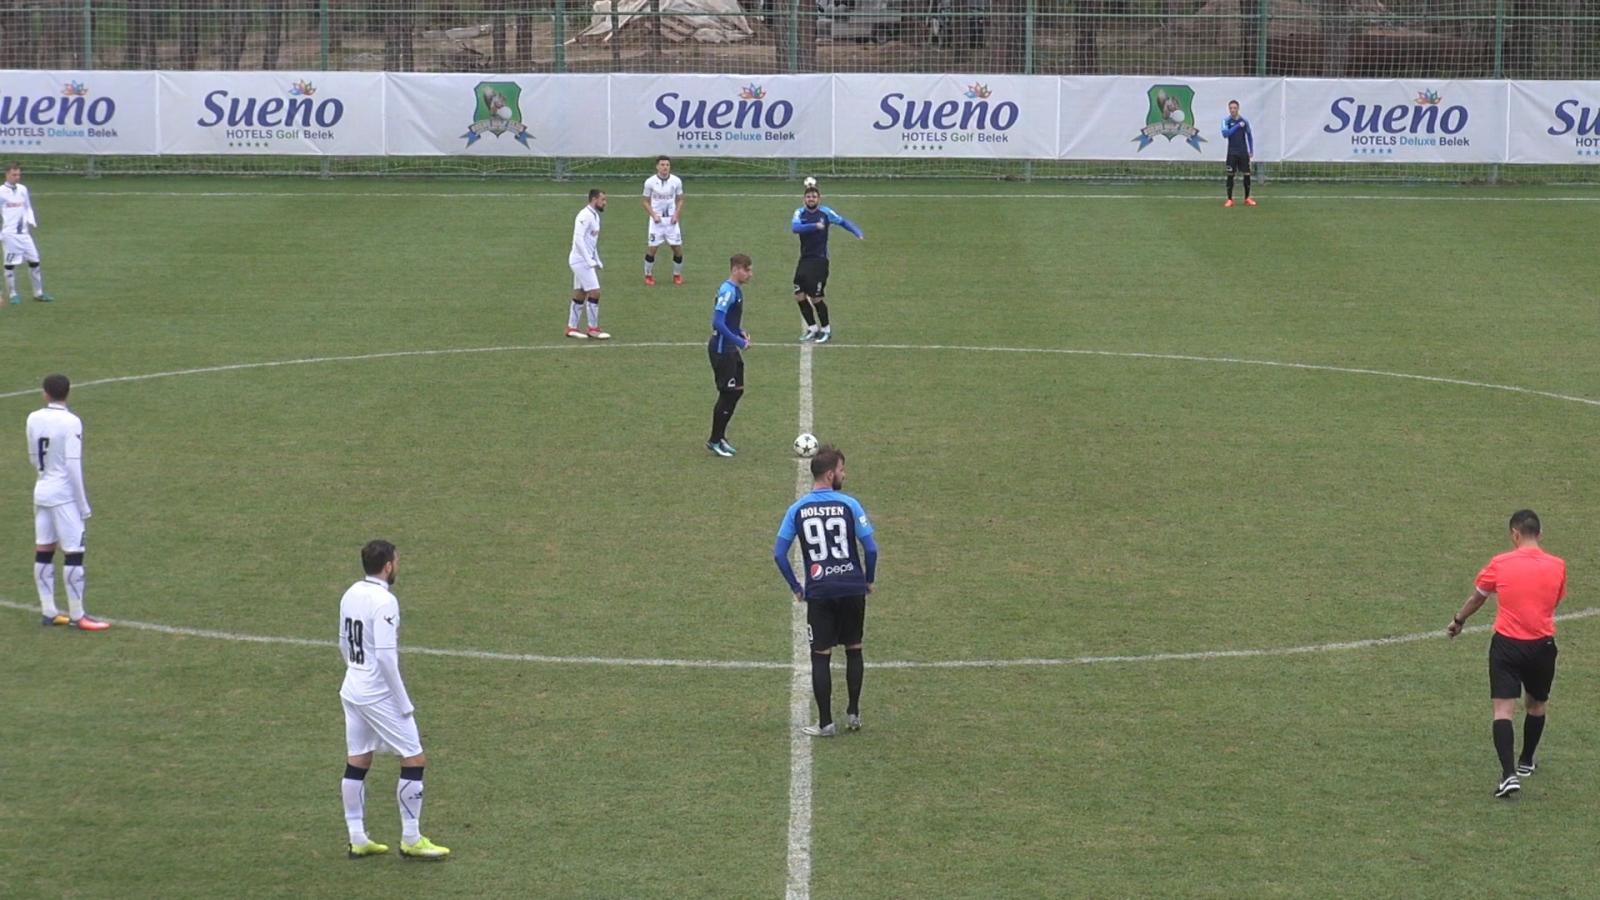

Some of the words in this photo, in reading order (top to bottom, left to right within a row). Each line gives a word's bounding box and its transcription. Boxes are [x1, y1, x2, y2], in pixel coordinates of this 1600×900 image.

[47, 128, 85, 138] Deluxe
[87, 128, 118, 138] Belek
[226, 129, 273, 139] HOTELS
[275, 129, 299, 140] Golf
[303, 130, 334, 140] Belek
[676, 131, 723, 141] HOTELS
[724, 131, 762, 142] Deluxe
[764, 132, 795, 141] Belek
[901, 132, 947, 142] HOTELS
[950, 132, 974, 143] Golf
[977, 132, 1009, 143] Belek
[1351, 135, 1397, 146] HOTELS
[1399, 136, 1437, 147] Deluxe
[1439, 136, 1470, 147] Belek
[800, 506, 844, 518] HOLSTEN
[803, 517, 850, 561] 93
[345, 617, 365, 665] 39
